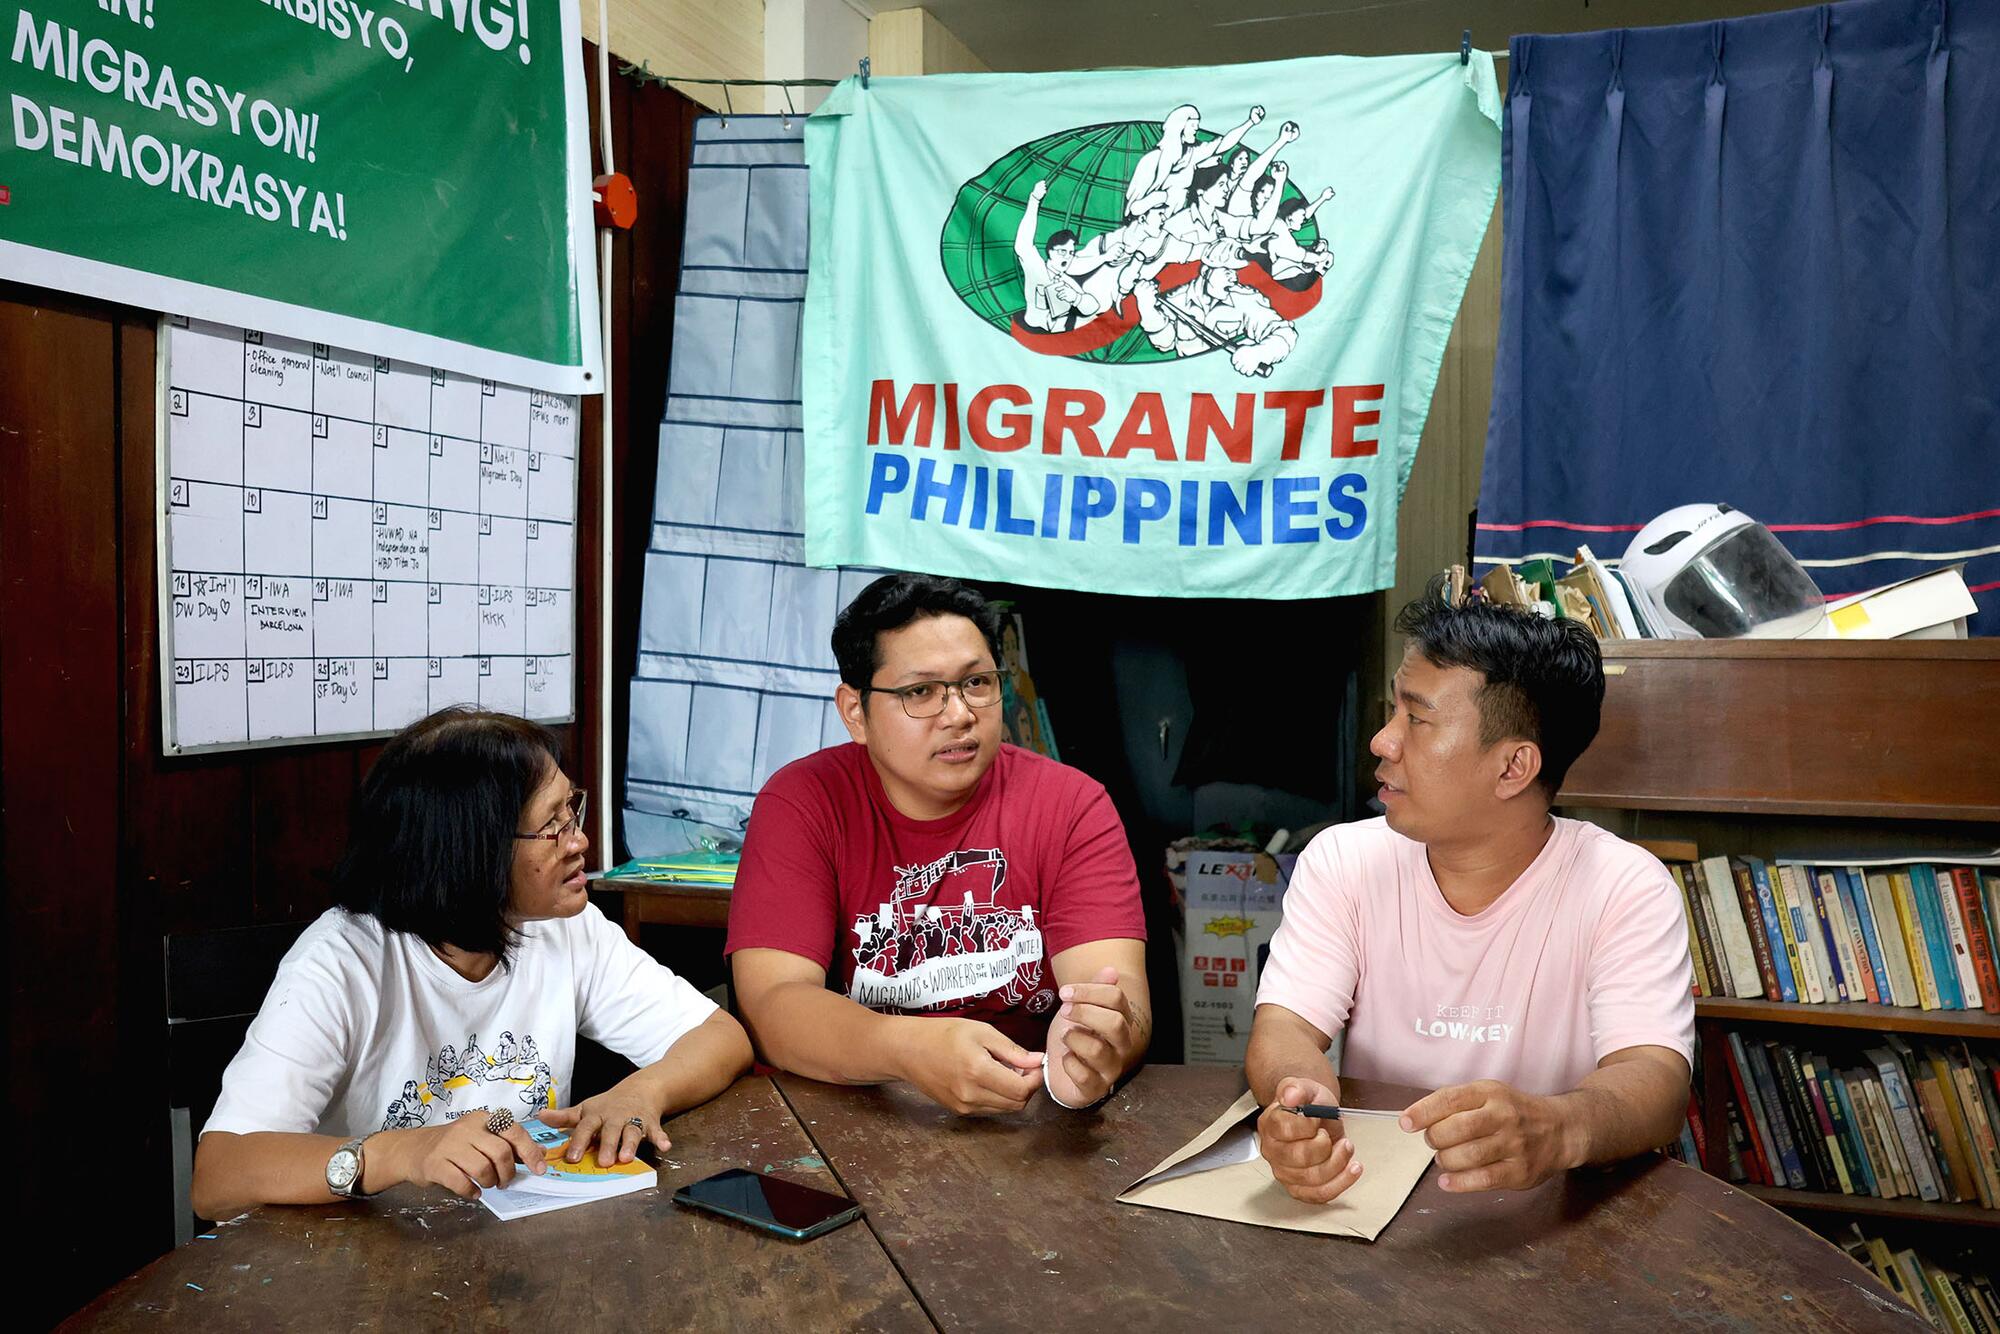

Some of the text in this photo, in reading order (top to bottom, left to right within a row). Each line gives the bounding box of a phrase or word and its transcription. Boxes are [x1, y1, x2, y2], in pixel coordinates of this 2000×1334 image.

[11, 9, 320, 163] MIGRASYON!
[10, 94, 348, 241] DEMOKRASYA!
[250, 363, 284, 386] cleaning
[346, 369, 373, 382] Council
[173, 394, 182, 409] 2
[248, 406, 256, 421] 3
[866, 378, 1385, 463] MIGRANTE
[315, 418, 322, 433] 4
[433, 439, 439, 449] 6
[530, 454, 536, 467] 8
[509, 470, 523, 489] Day
[173, 485, 182, 499] 9
[247, 492, 256, 506] 10
[865, 452, 1368, 547] PHILIPPINES
[314, 500, 324, 514] 11
[374, 506, 384, 520] 12
[480, 518, 488, 530] 14
[529, 523, 536, 534] 15
[174, 575, 185, 591] 16
[247, 579, 259, 591] 17
[315, 581, 325, 593] 18
[375, 586, 384, 597] 19
[480, 589, 488, 599] 21
[526, 589, 536, 600] 22
[539, 591, 557, 606] ILPS
[175, 602, 218, 622] DW Day
[250, 604, 307, 618] INTERVIEW
[260, 620, 304, 632] BARCELONA
[482, 610, 506, 629] KKK
[175, 665, 190, 679] 23
[195, 662, 230, 682] ILPS
[249, 663, 260, 676] 24
[266, 662, 294, 680] ILPS
[317, 663, 328, 675] 25
[317, 682, 347, 704] SF Day
[1750, 908, 1765, 949] CATCHING
[859, 976, 922, 1006] MIGRANTS
[923, 979, 929, 989] &
[929, 962, 977, 994] WORKERS
[989, 954, 1016, 979] WORLD
[1436, 1004, 1504, 1020] KEEP IT
[445, 1105, 489, 1120] REINFE
